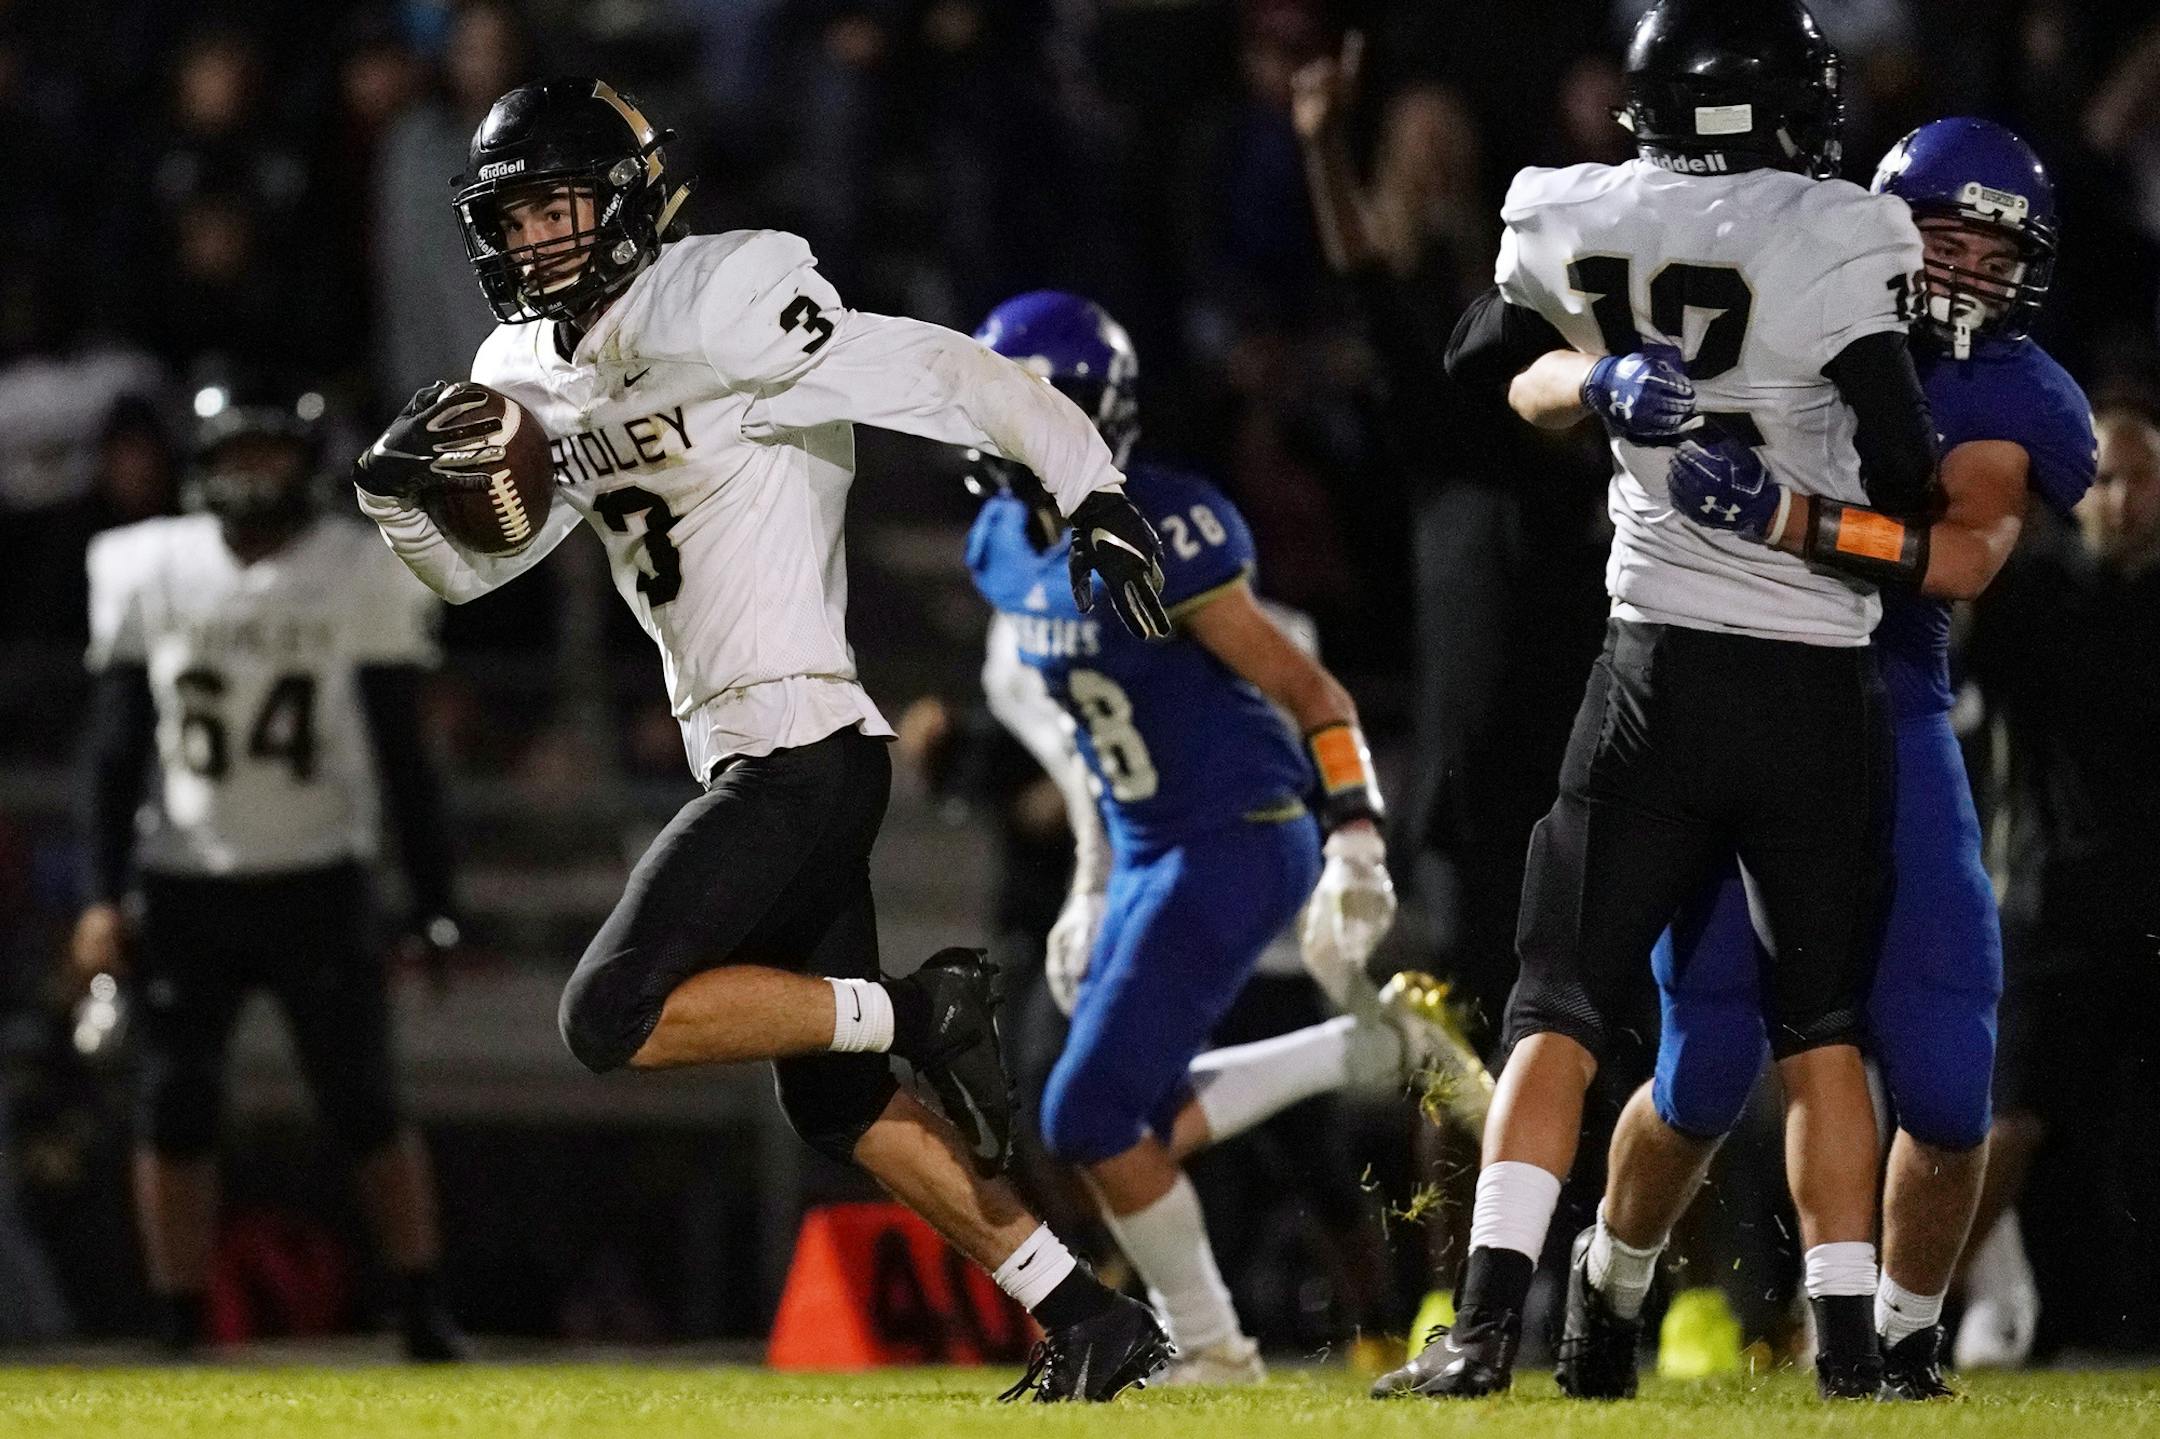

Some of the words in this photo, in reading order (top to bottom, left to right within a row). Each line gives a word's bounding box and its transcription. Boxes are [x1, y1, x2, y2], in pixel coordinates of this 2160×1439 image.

[478, 159, 525, 181] Riddell
[779, 294, 835, 355] 3
[1566, 255, 1768, 446] 12
[549, 406, 693, 486] RIDLEY
[592, 486, 687, 608] 3
[1161, 504, 1228, 563] 28
[174, 667, 320, 783] 64
